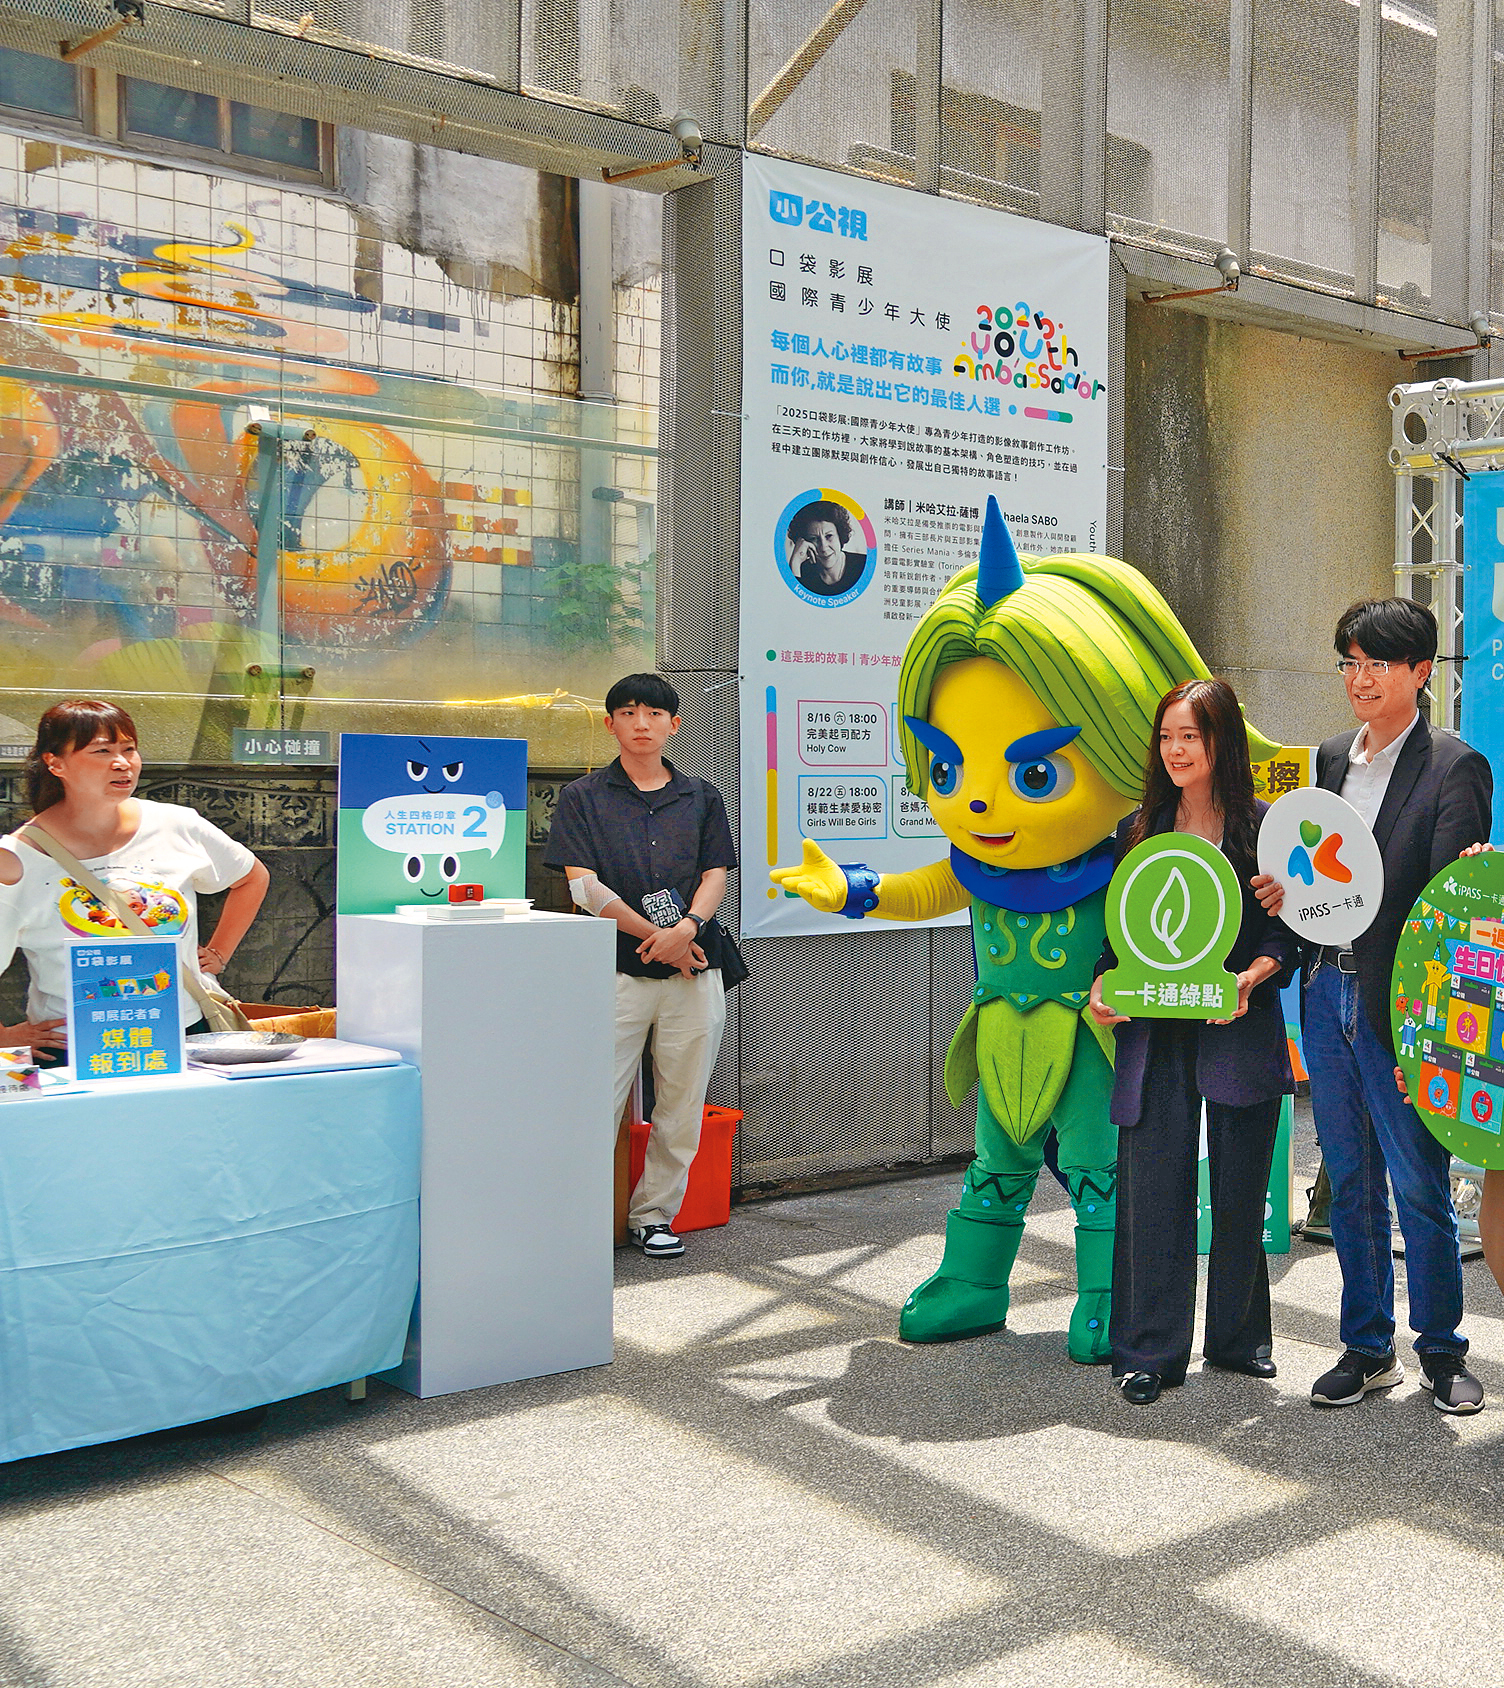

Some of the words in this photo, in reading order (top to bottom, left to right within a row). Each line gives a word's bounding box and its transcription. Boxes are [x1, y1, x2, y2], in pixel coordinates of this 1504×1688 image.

[770, 190, 868, 241] 小公視
[770, 249, 873, 286] 口袋影展
[770, 280, 951, 332] 國際青少年大使
[977, 301, 1055, 340] 2025
[771, 329, 943, 376] 每個人心裡都有故事
[1003, 511, 1029, 524] haela
[1031, 514, 1058, 527] SABO
[1088, 520, 1098, 553] Youth
[827, 588, 860, 608] Speaker
[807, 712, 831, 723] 8/16
[849, 713, 877, 723] 18:00
[806, 728, 871, 740] 完美起司配方
[244, 738, 321, 756] 小心碰撞
[806, 744, 825, 754] Holy
[827, 744, 847, 752] Cow
[807, 787, 832, 798] 8/22
[849, 787, 878, 797] 18:00
[384, 804, 456, 820] 人生四格印章
[807, 802, 882, 814] 模範生禁愛秘密
[385, 822, 455, 835] STATION
[462, 805, 487, 837] 2
[806, 818, 826, 827] Girls
[829, 818, 844, 827] Will
[845, 818, 856, 826] Be
[858, 817, 877, 826] Girls
[900, 817, 924, 826] Grand
[1457, 885, 1482, 900] iPASS
[1298, 903, 1331, 921] iPASS
[1332, 894, 1364, 909] 一卡通
[1114, 982, 1223, 1008] 一卡通綠點
[91, 1007, 162, 1022] 開展記者會
[102, 1027, 153, 1049] 媒體
[89, 1050, 168, 1075] 報到處
